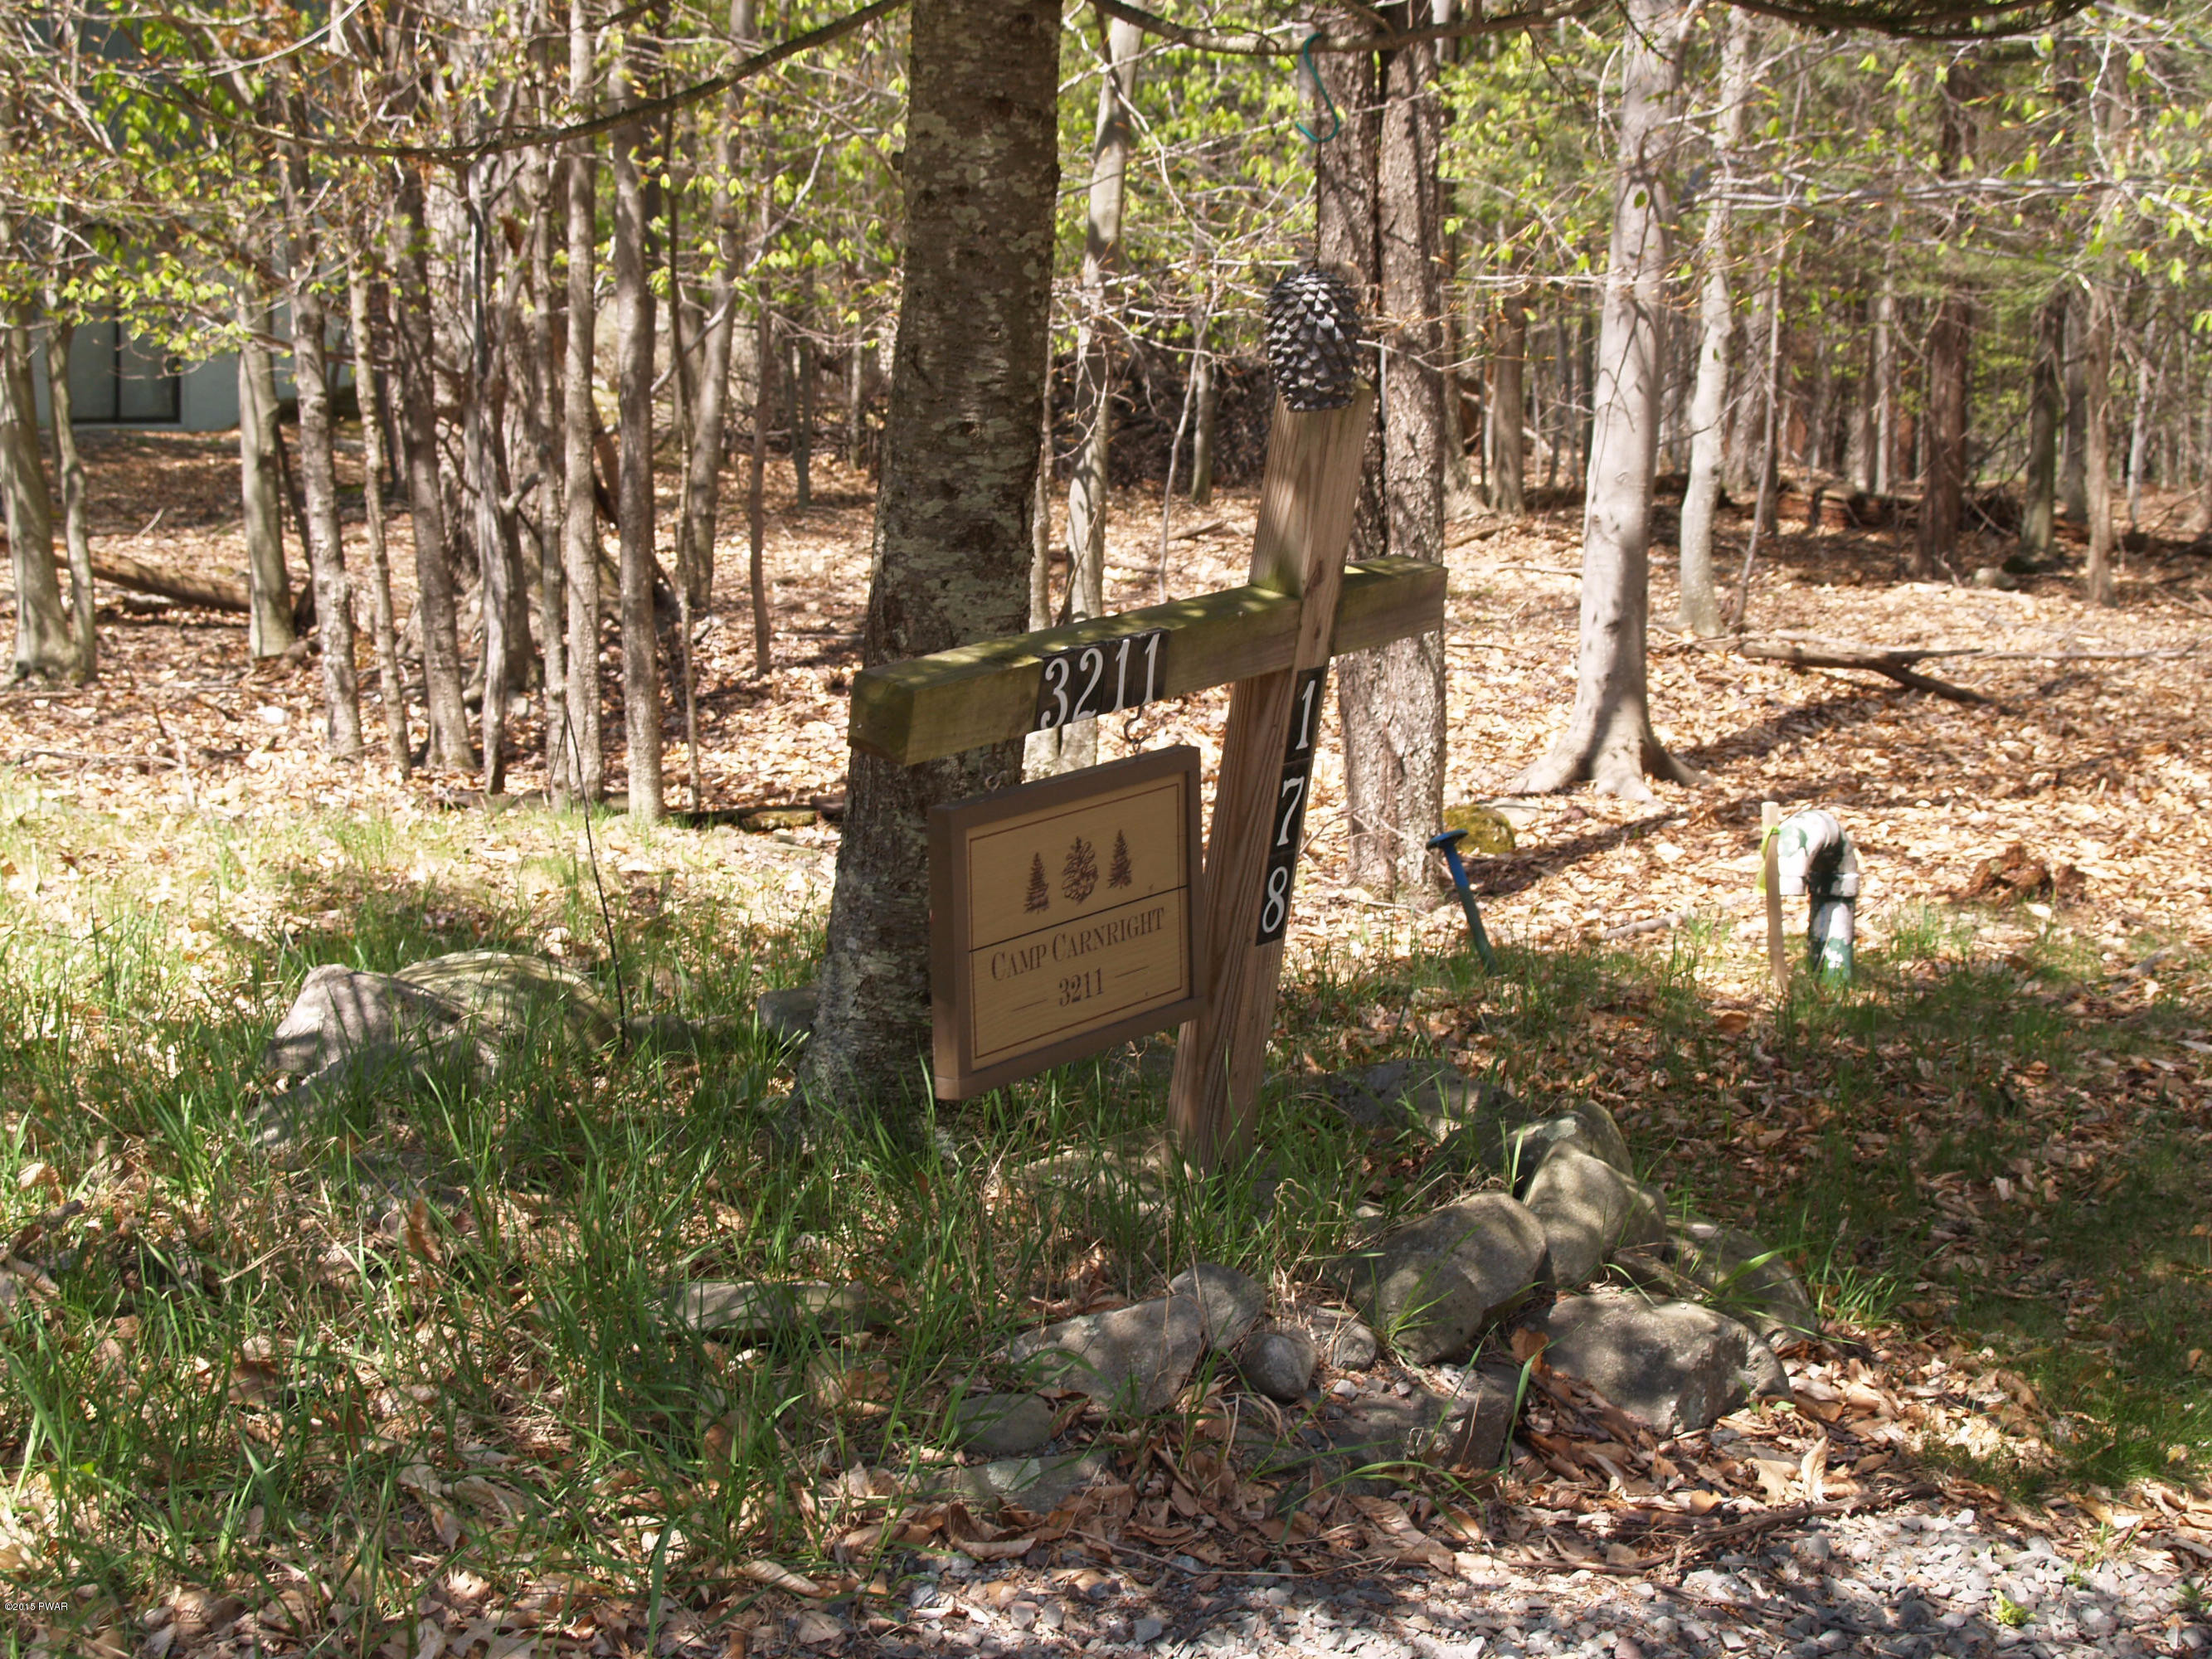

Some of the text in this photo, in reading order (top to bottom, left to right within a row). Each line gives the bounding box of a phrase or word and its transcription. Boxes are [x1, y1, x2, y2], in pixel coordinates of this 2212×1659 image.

[1040, 633, 1160, 730] 3211
[1262, 679, 1315, 934] 178
[991, 907, 1165, 981] CAMP CARNRIGHT
[1058, 966, 1104, 1007] 3211
